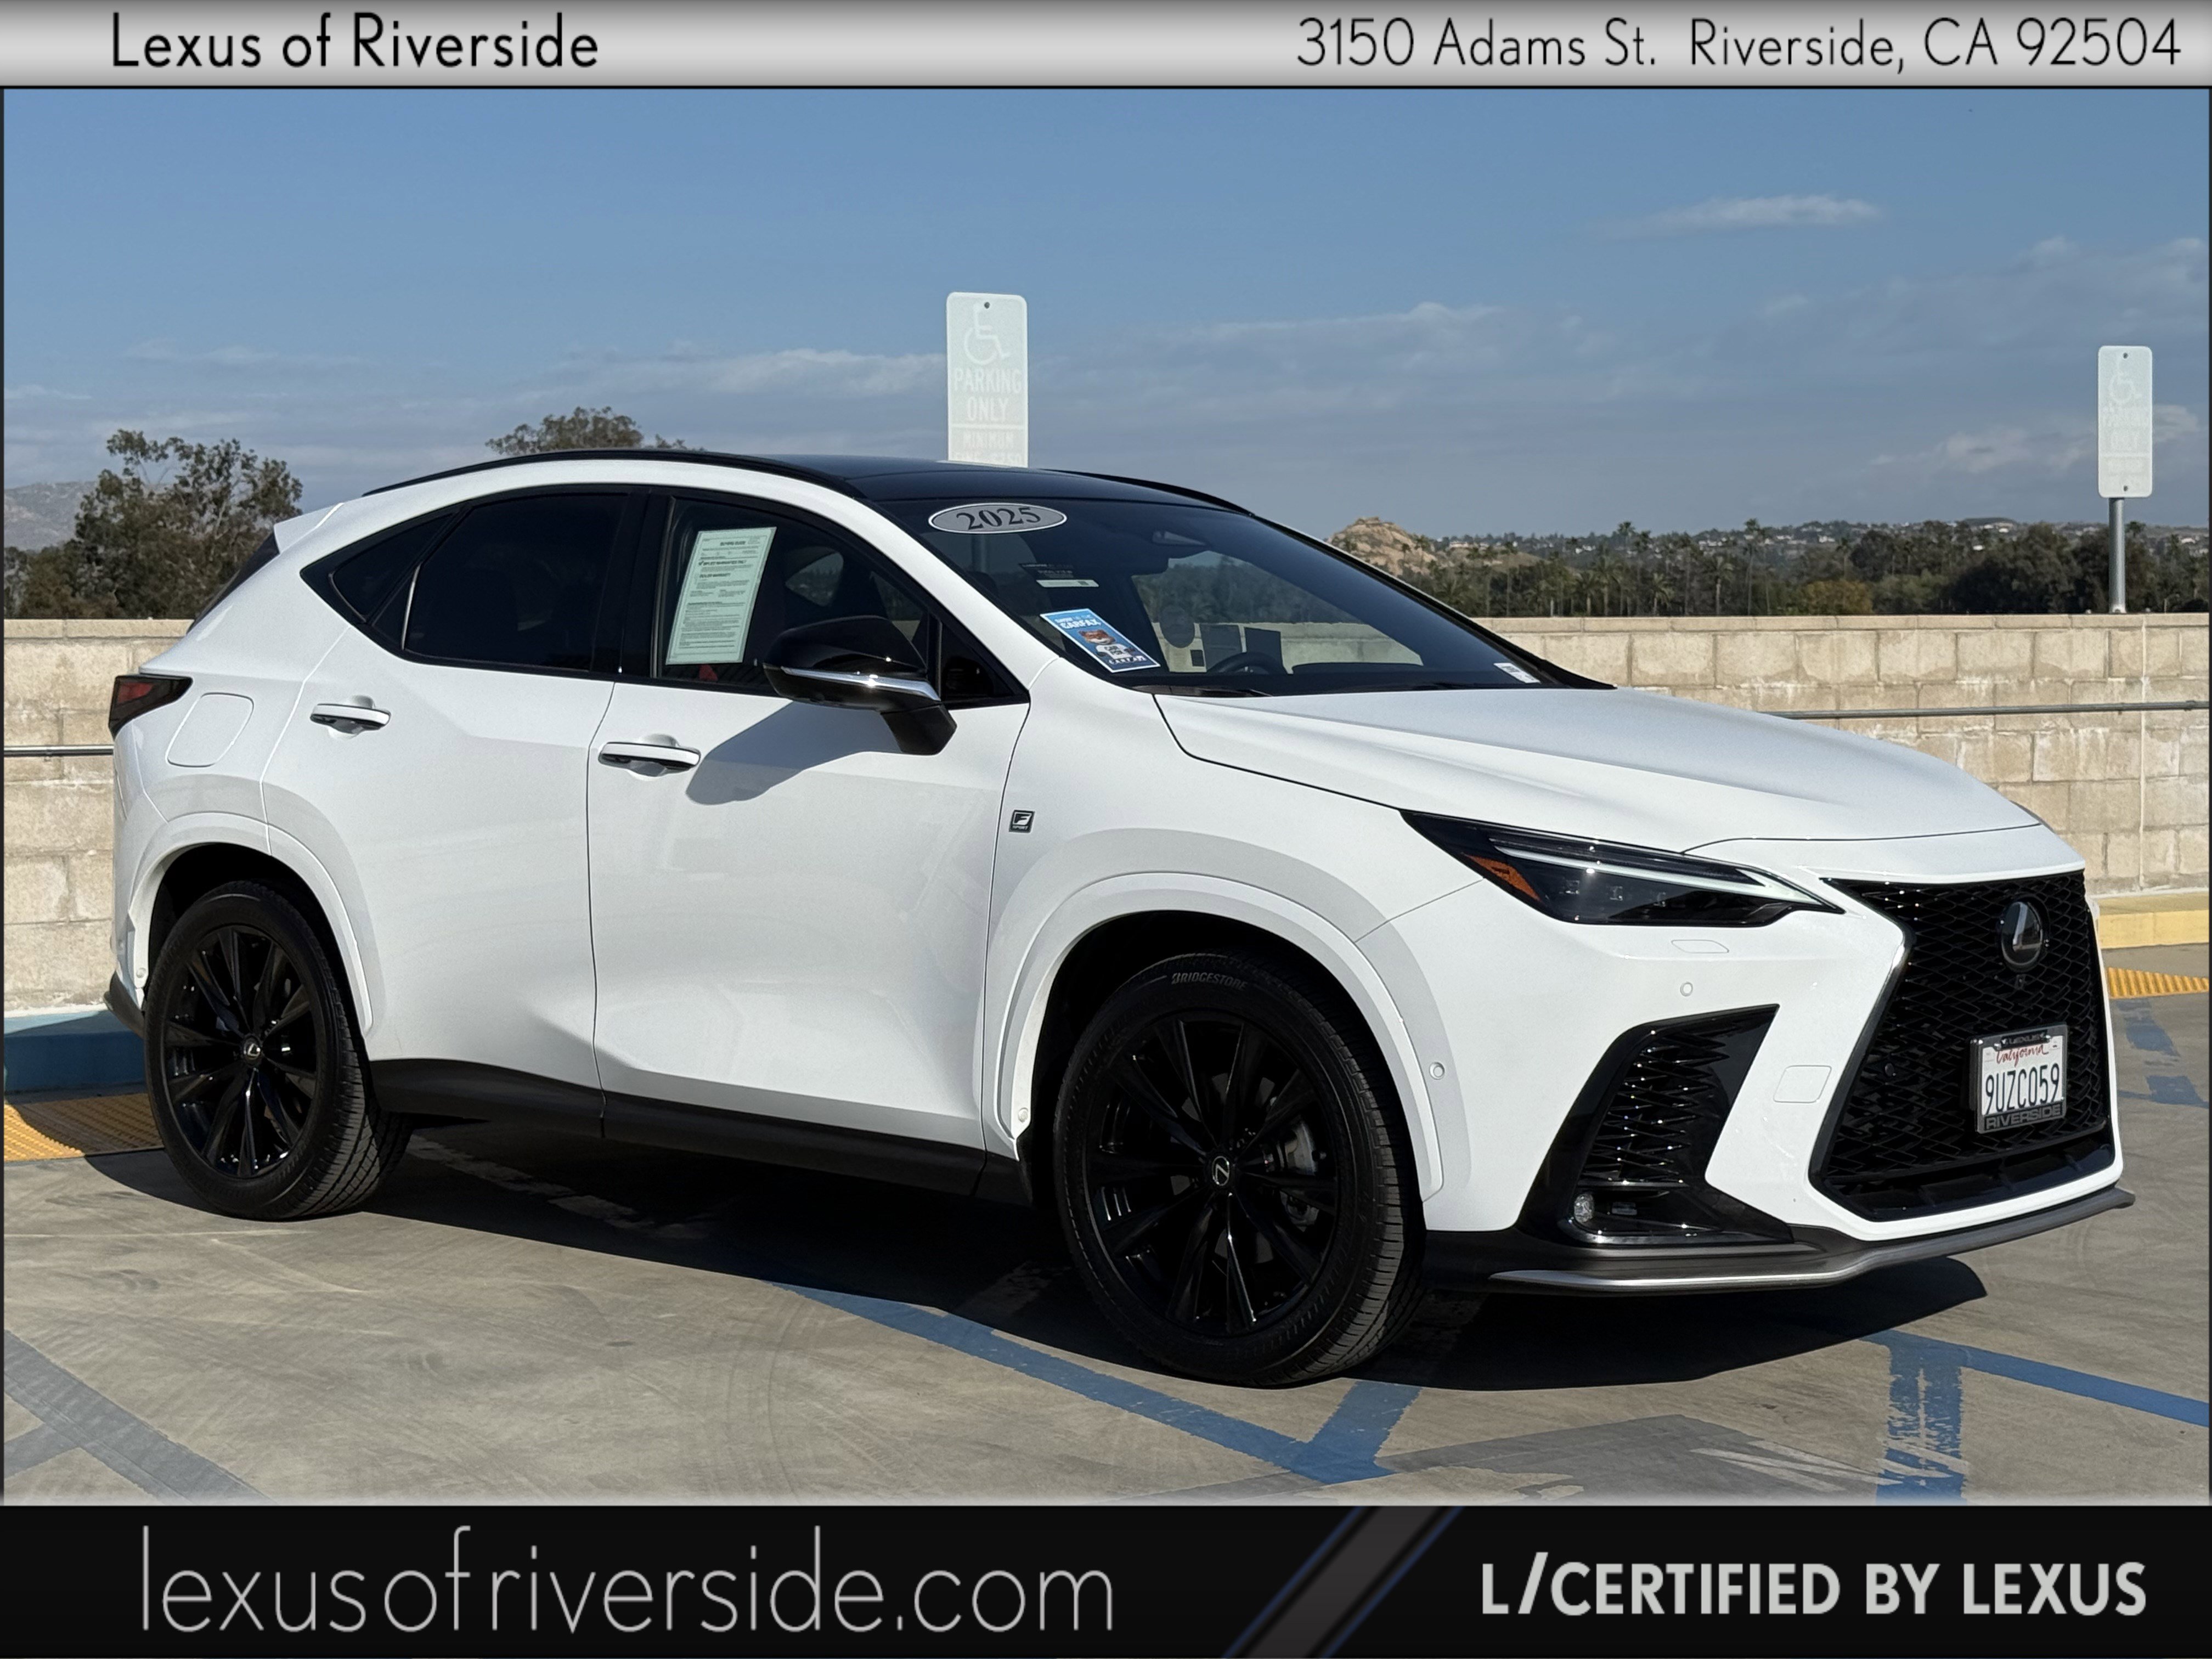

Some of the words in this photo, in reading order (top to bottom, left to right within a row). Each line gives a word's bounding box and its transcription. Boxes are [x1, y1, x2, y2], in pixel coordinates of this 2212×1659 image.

[954, 367, 1022, 394] PARKING
[967, 396, 1009, 422] ONLY
[956, 507, 1041, 531] 2025
[1171, 972, 1248, 991] BRIDGESTONE
[1996, 1044, 2049, 1068] California
[1985, 1062, 2060, 1115] 9UZC059
[1987, 1104, 2061, 1129] RIVERSIDE
